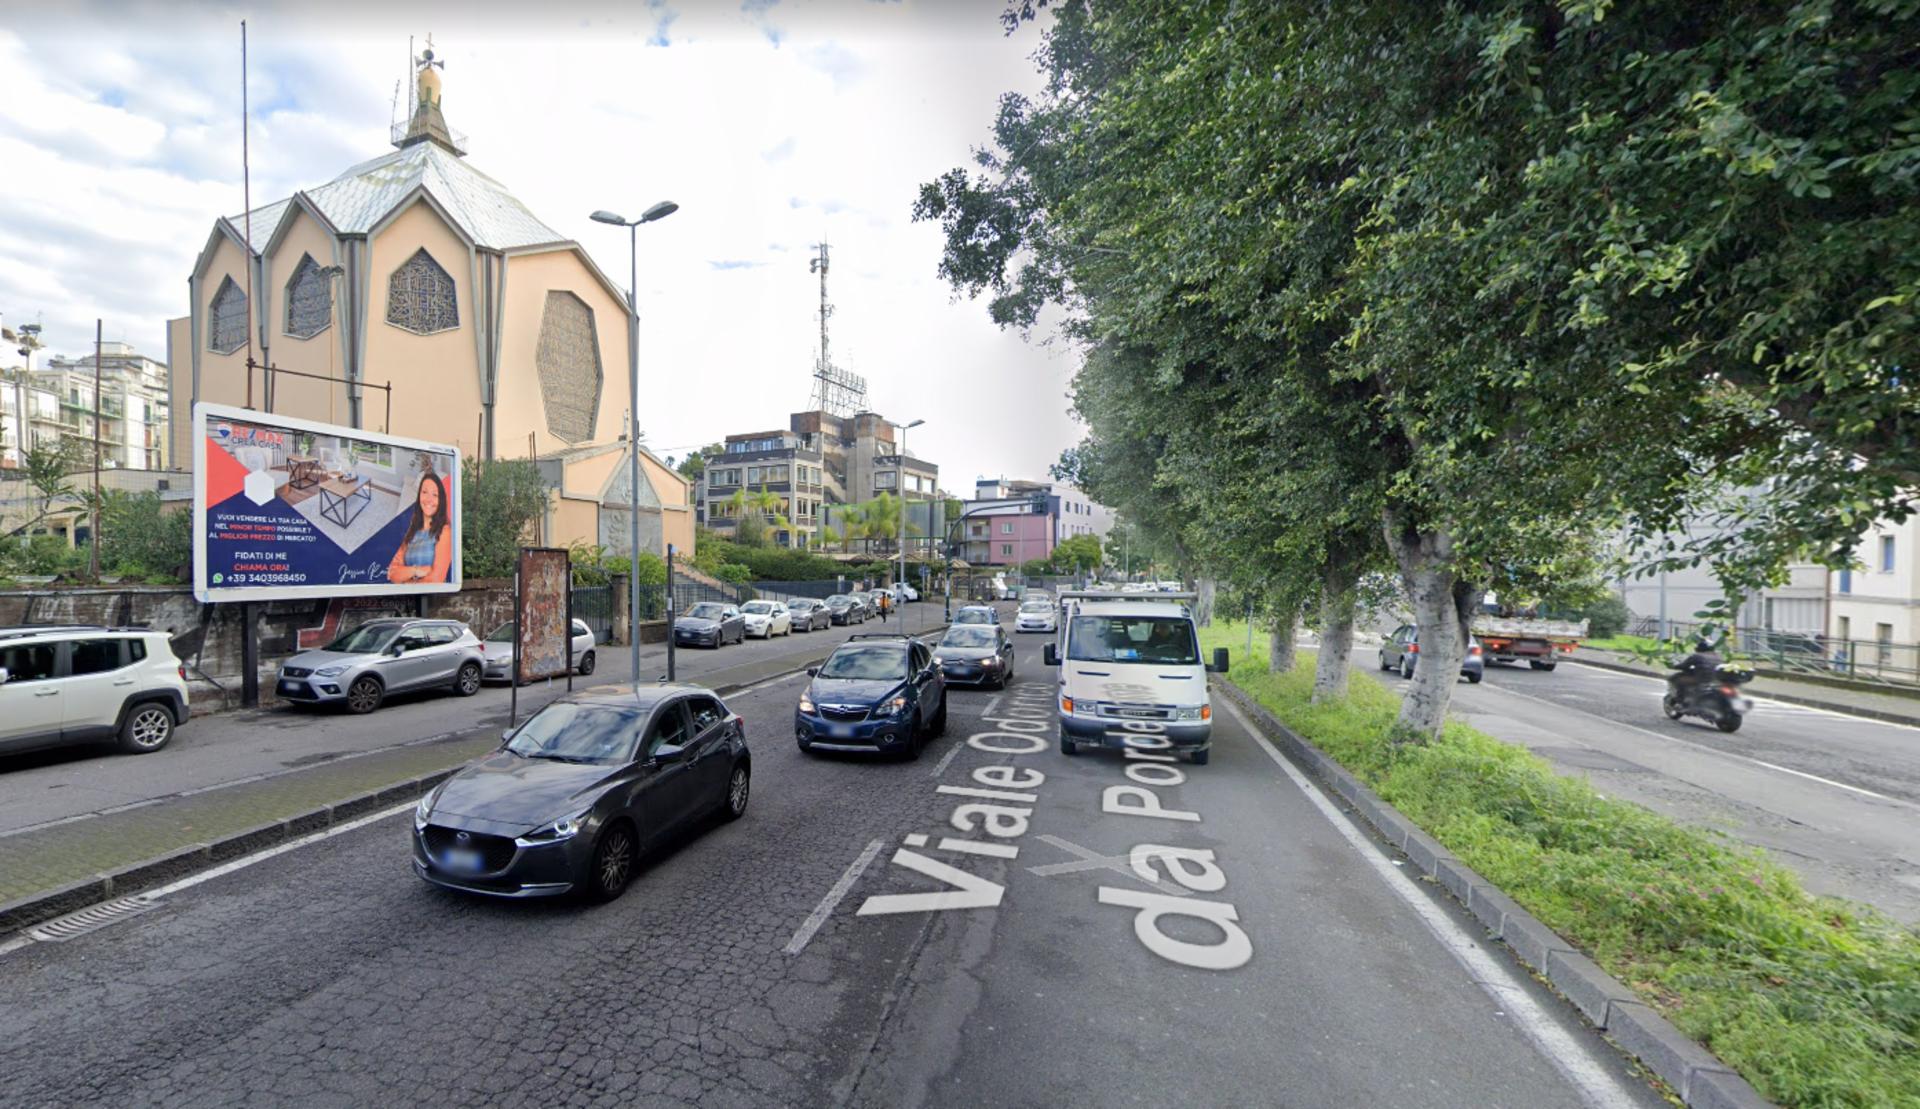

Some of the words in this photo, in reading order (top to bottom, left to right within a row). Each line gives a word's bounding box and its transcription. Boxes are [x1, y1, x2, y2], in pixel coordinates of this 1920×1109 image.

[231, 436, 256, 447] CREA
[258, 440, 282, 450] CASA
[217, 513, 235, 521] VUOI
[236, 514, 267, 523] VENDERE
[268, 515, 277, 523] LA
[291, 517, 308, 525] CASA
[229, 523, 253, 531] MINOR
[254, 524, 276, 532] TEMPO
[219, 532, 249, 540] MIGLIOR
[250, 533, 276, 541] PREZZO
[276, 534, 284, 542] DI
[234, 551, 264, 560] FIDATI
[265, 552, 274, 560] DI
[275, 552, 288, 560] ME
[233, 563, 268, 571] CHIAMA
[270, 563, 290, 571] ORA!
[226, 574, 246, 582] +39
[248, 573, 307, 582] 3403968450
